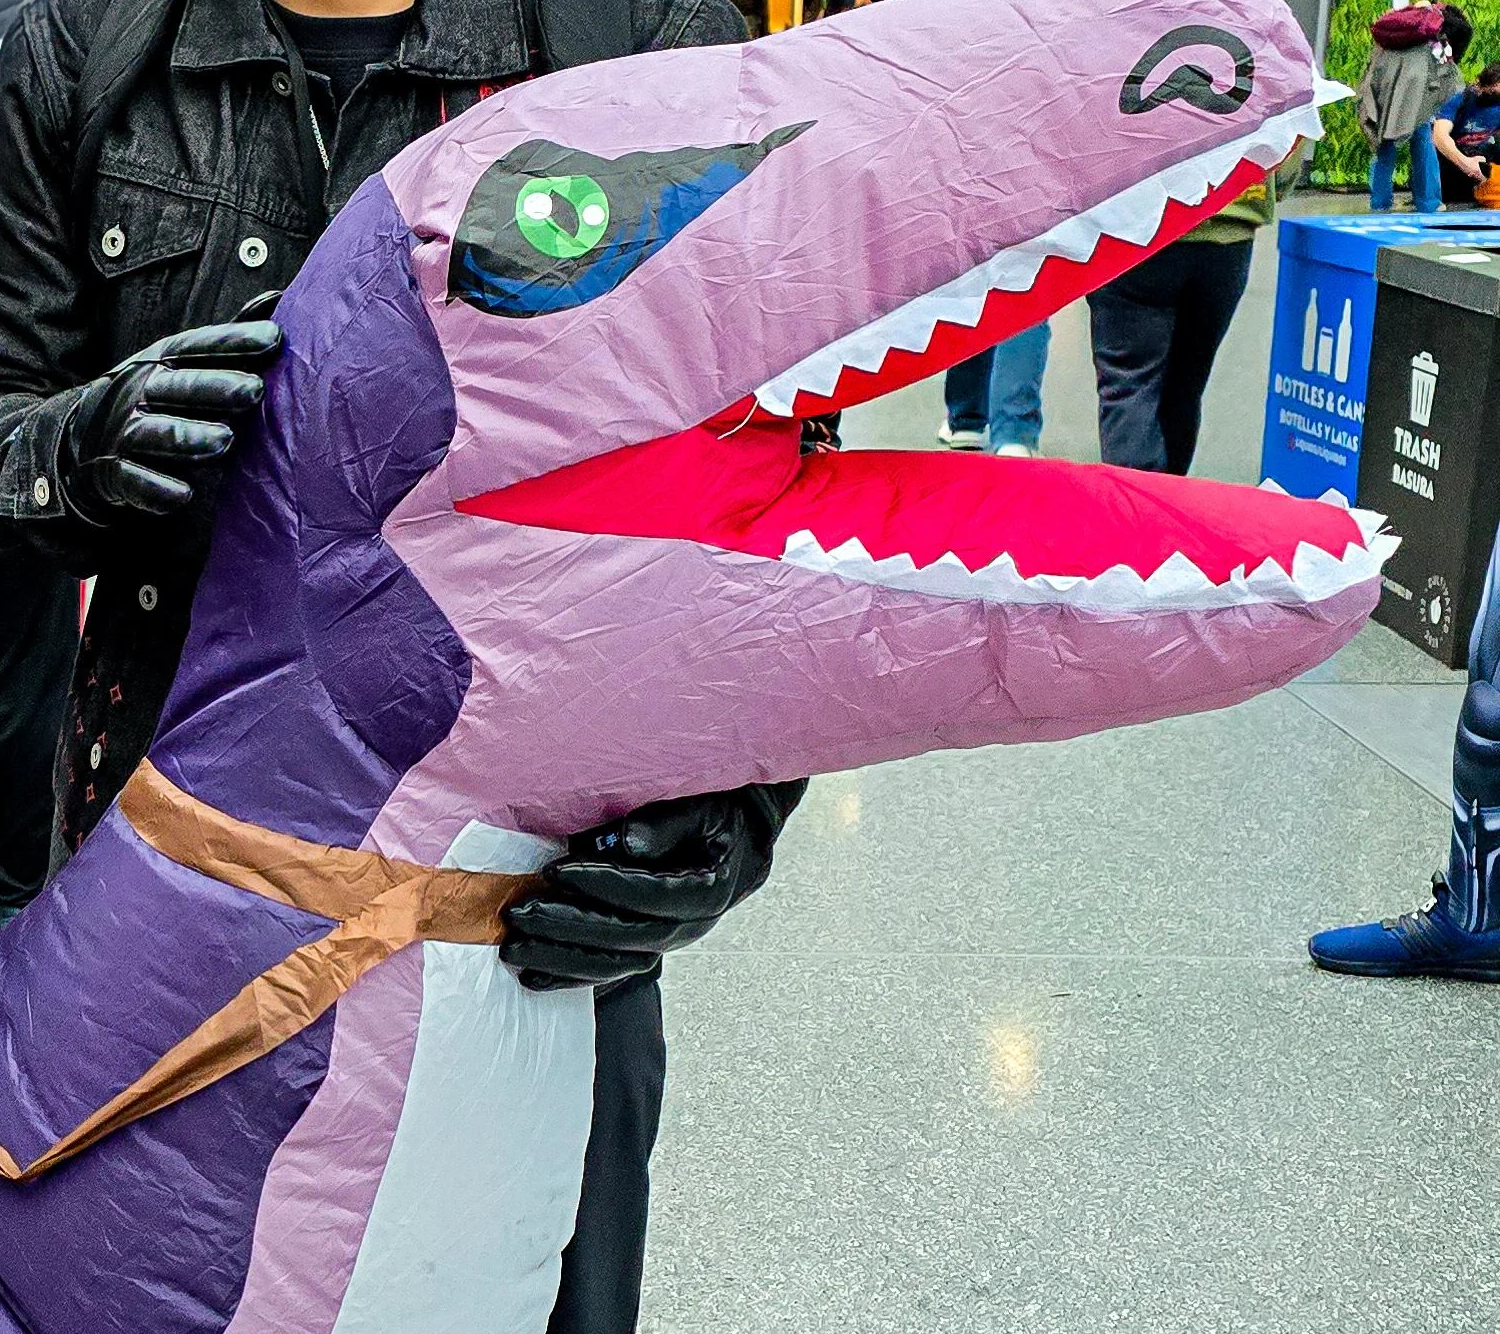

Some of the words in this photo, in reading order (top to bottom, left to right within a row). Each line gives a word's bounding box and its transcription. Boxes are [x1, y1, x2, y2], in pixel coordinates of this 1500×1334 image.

[1274, 373, 1325, 409] BOTTLES
[1326, 391, 1335, 413] &
[1279, 408, 1323, 438] BOTELLAS
[1325, 424, 1331, 441] Y
[1331, 427, 1359, 452] LATAS
[1394, 426, 1441, 471] TRASH
[1392, 463, 1435, 501] BASURA
